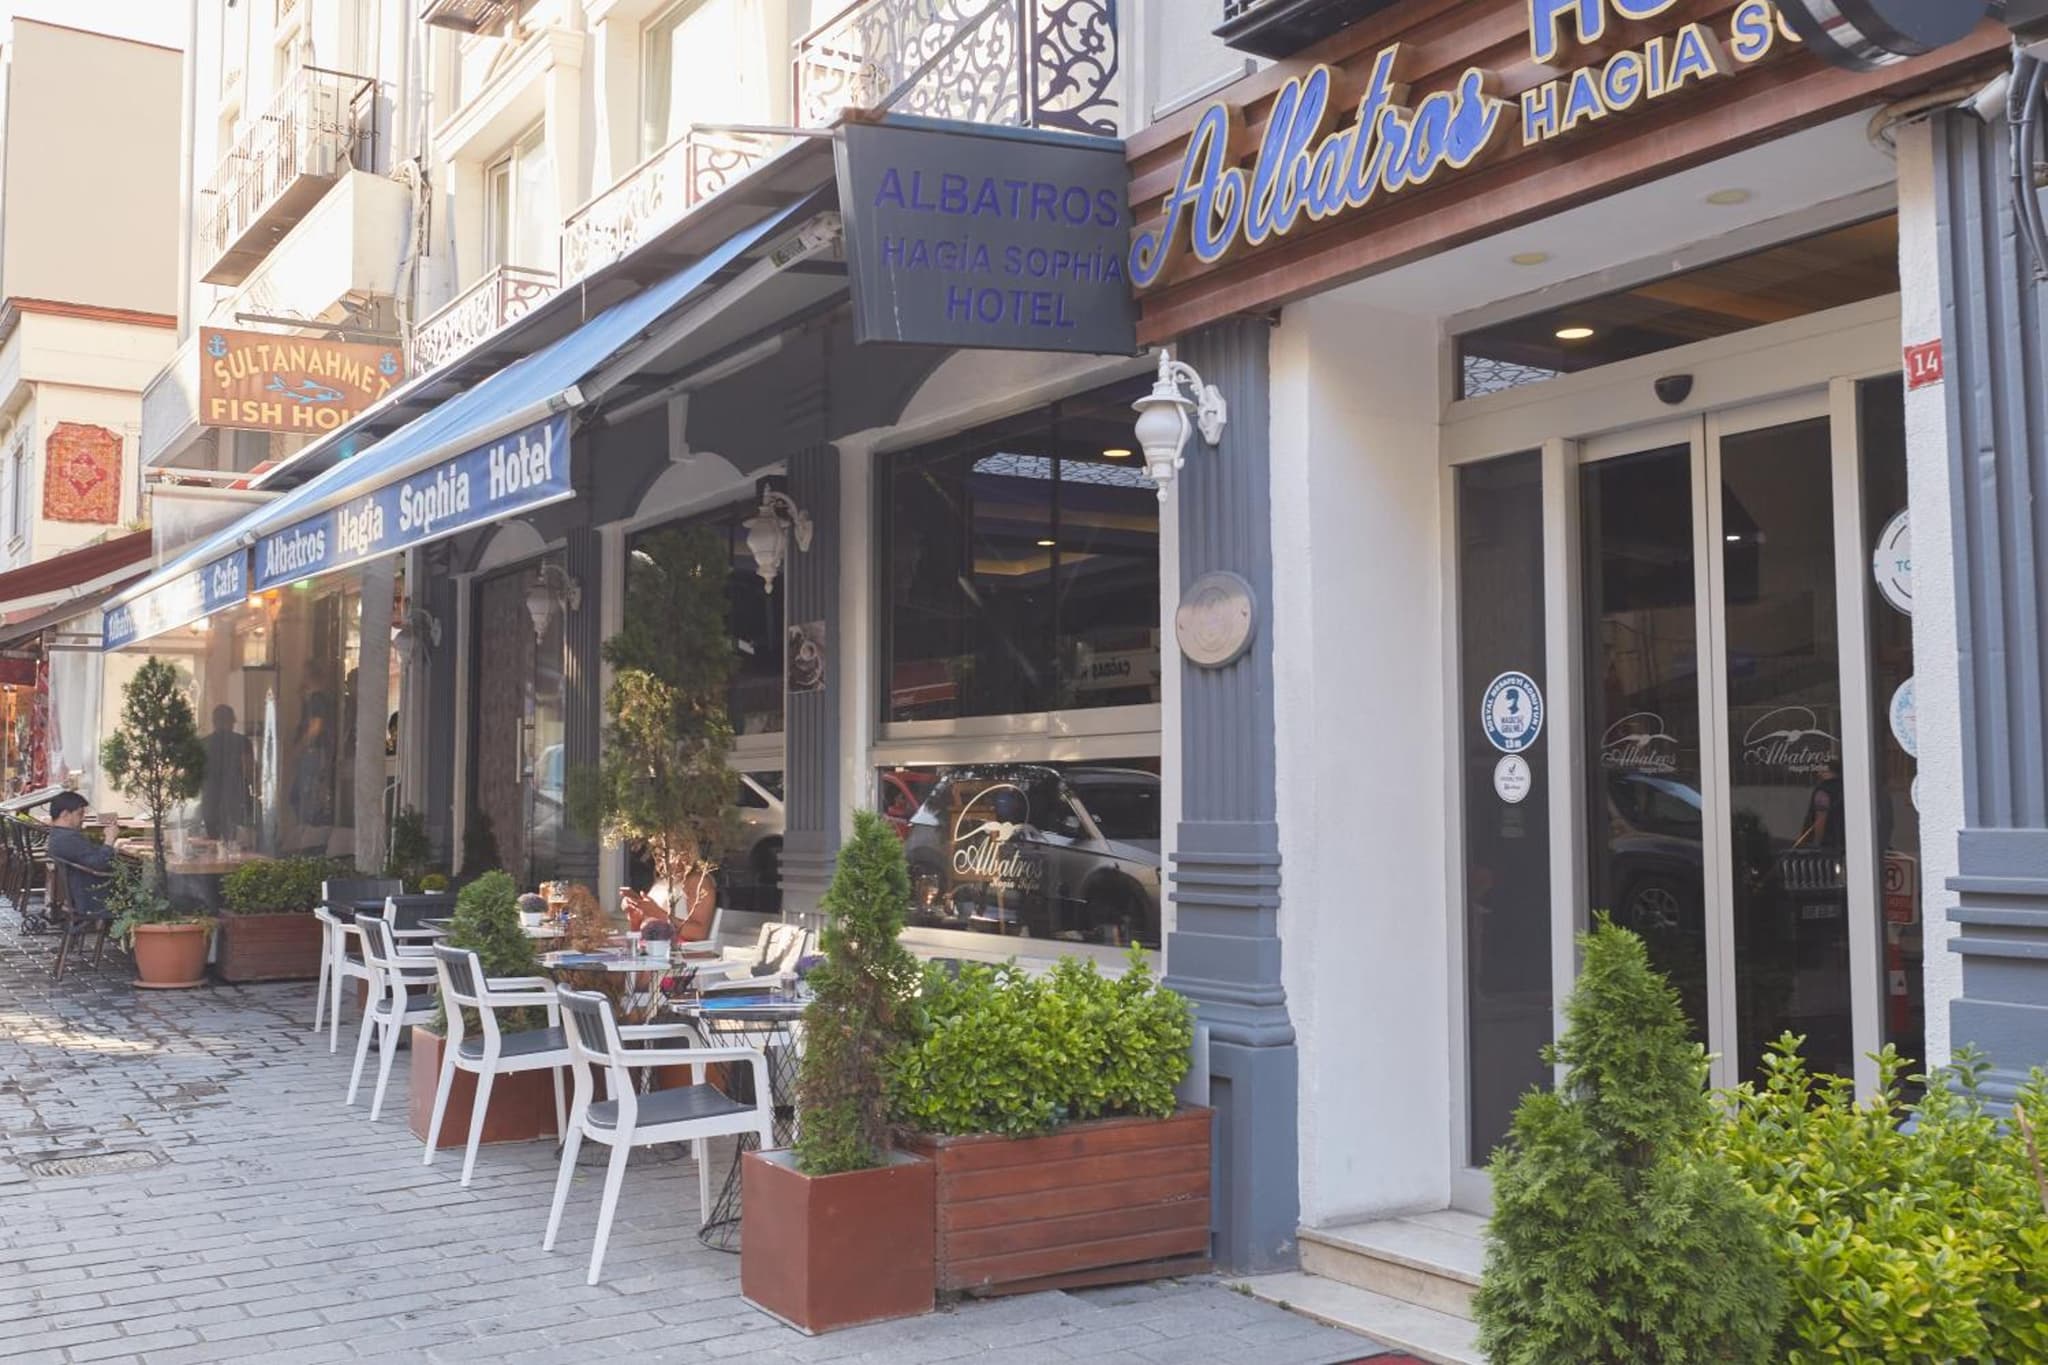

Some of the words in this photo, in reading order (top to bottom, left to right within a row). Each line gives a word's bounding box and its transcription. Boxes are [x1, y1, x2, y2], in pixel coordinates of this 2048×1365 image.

[1521, 22, 1718, 147] HAGIA
[1731, 0, 1802, 63] S
[1127, 42, 1503, 288] Albatros
[874, 168, 1120, 228] ALBATROS
[946, 285, 1076, 329] HOTEL
[214, 344, 391, 400] SULTANAHMET
[1914, 350, 1938, 377] 14
[211, 398, 283, 425] FISH
[264, 526, 325, 577] Albatros
[337, 497, 384, 556] Hagia
[400, 463, 470, 534] Sophia
[489, 424, 553, 500] Hotel
[212, 557, 239, 600] Cafe
[1602, 743, 1677, 769] Albatros
[1744, 740, 1832, 767] Albatros
[953, 835, 1042, 876] Albatros
